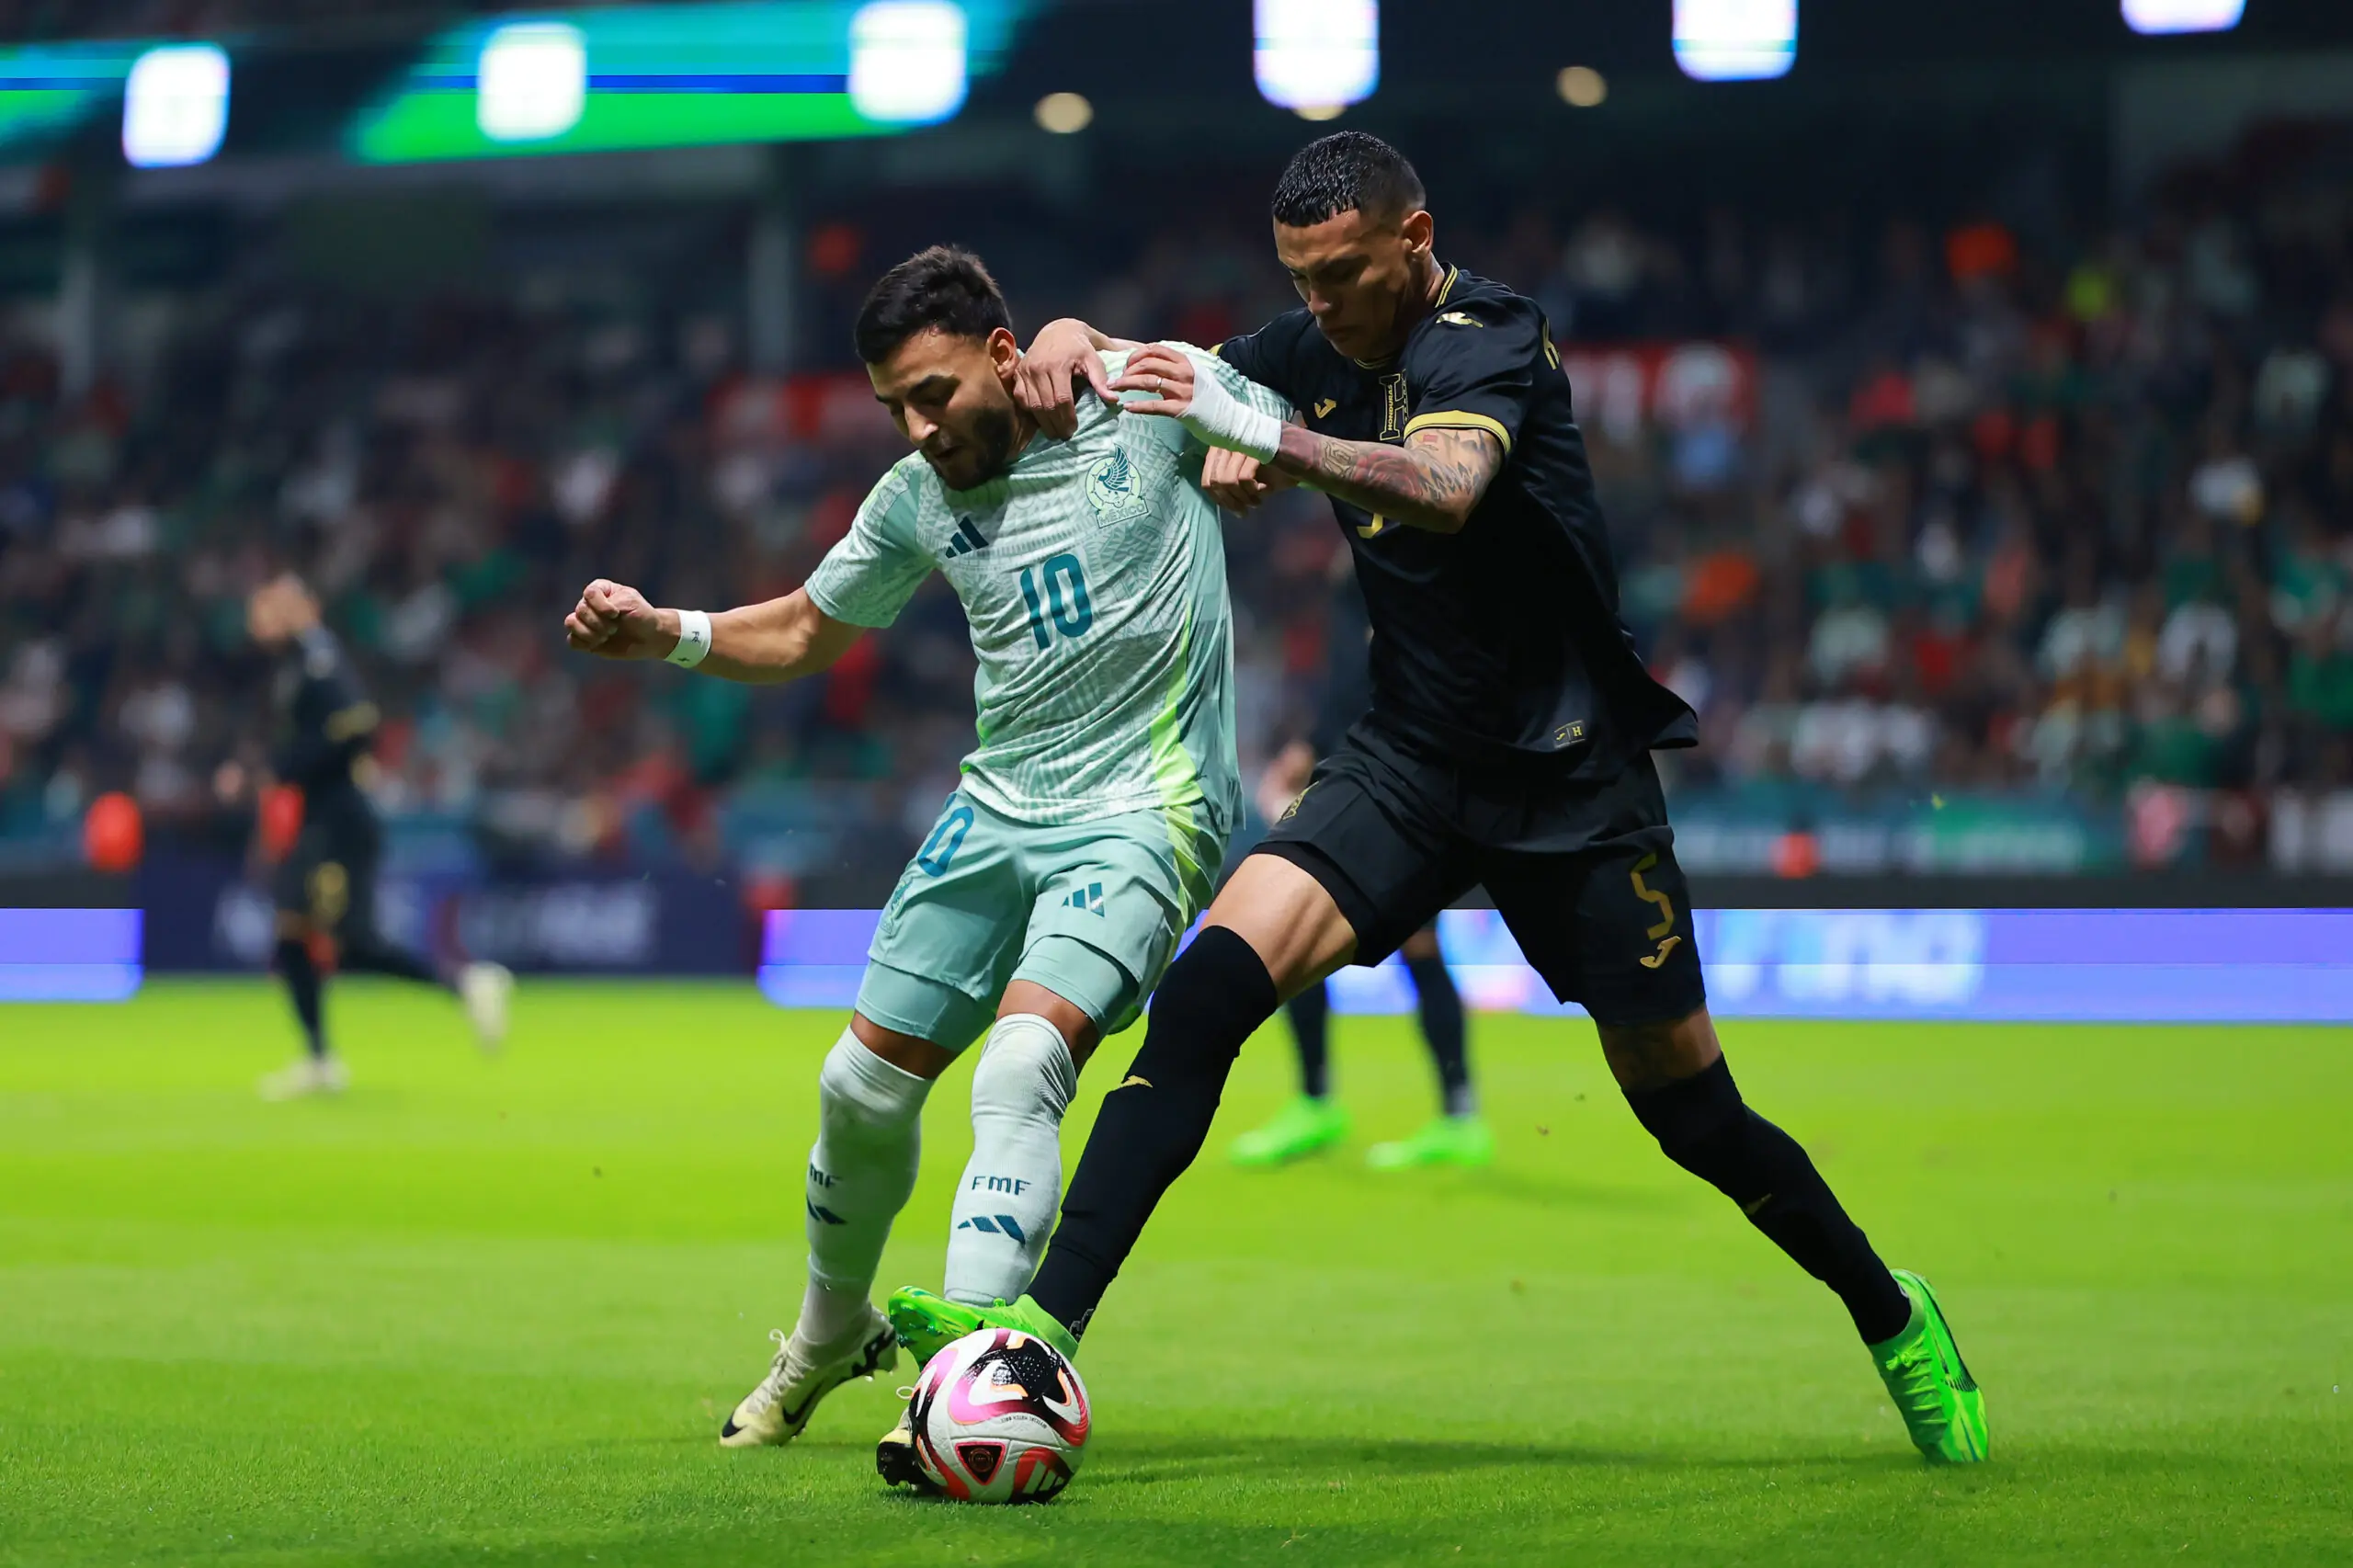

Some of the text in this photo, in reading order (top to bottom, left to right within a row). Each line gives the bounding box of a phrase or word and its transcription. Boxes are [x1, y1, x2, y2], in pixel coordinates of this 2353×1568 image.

[1019, 553, 1093, 650] 10
[1573, 726, 1583, 737] H
[917, 792, 974, 878] 0
[1630, 852, 1674, 941] 5
[972, 1176, 1031, 1196] FMF
